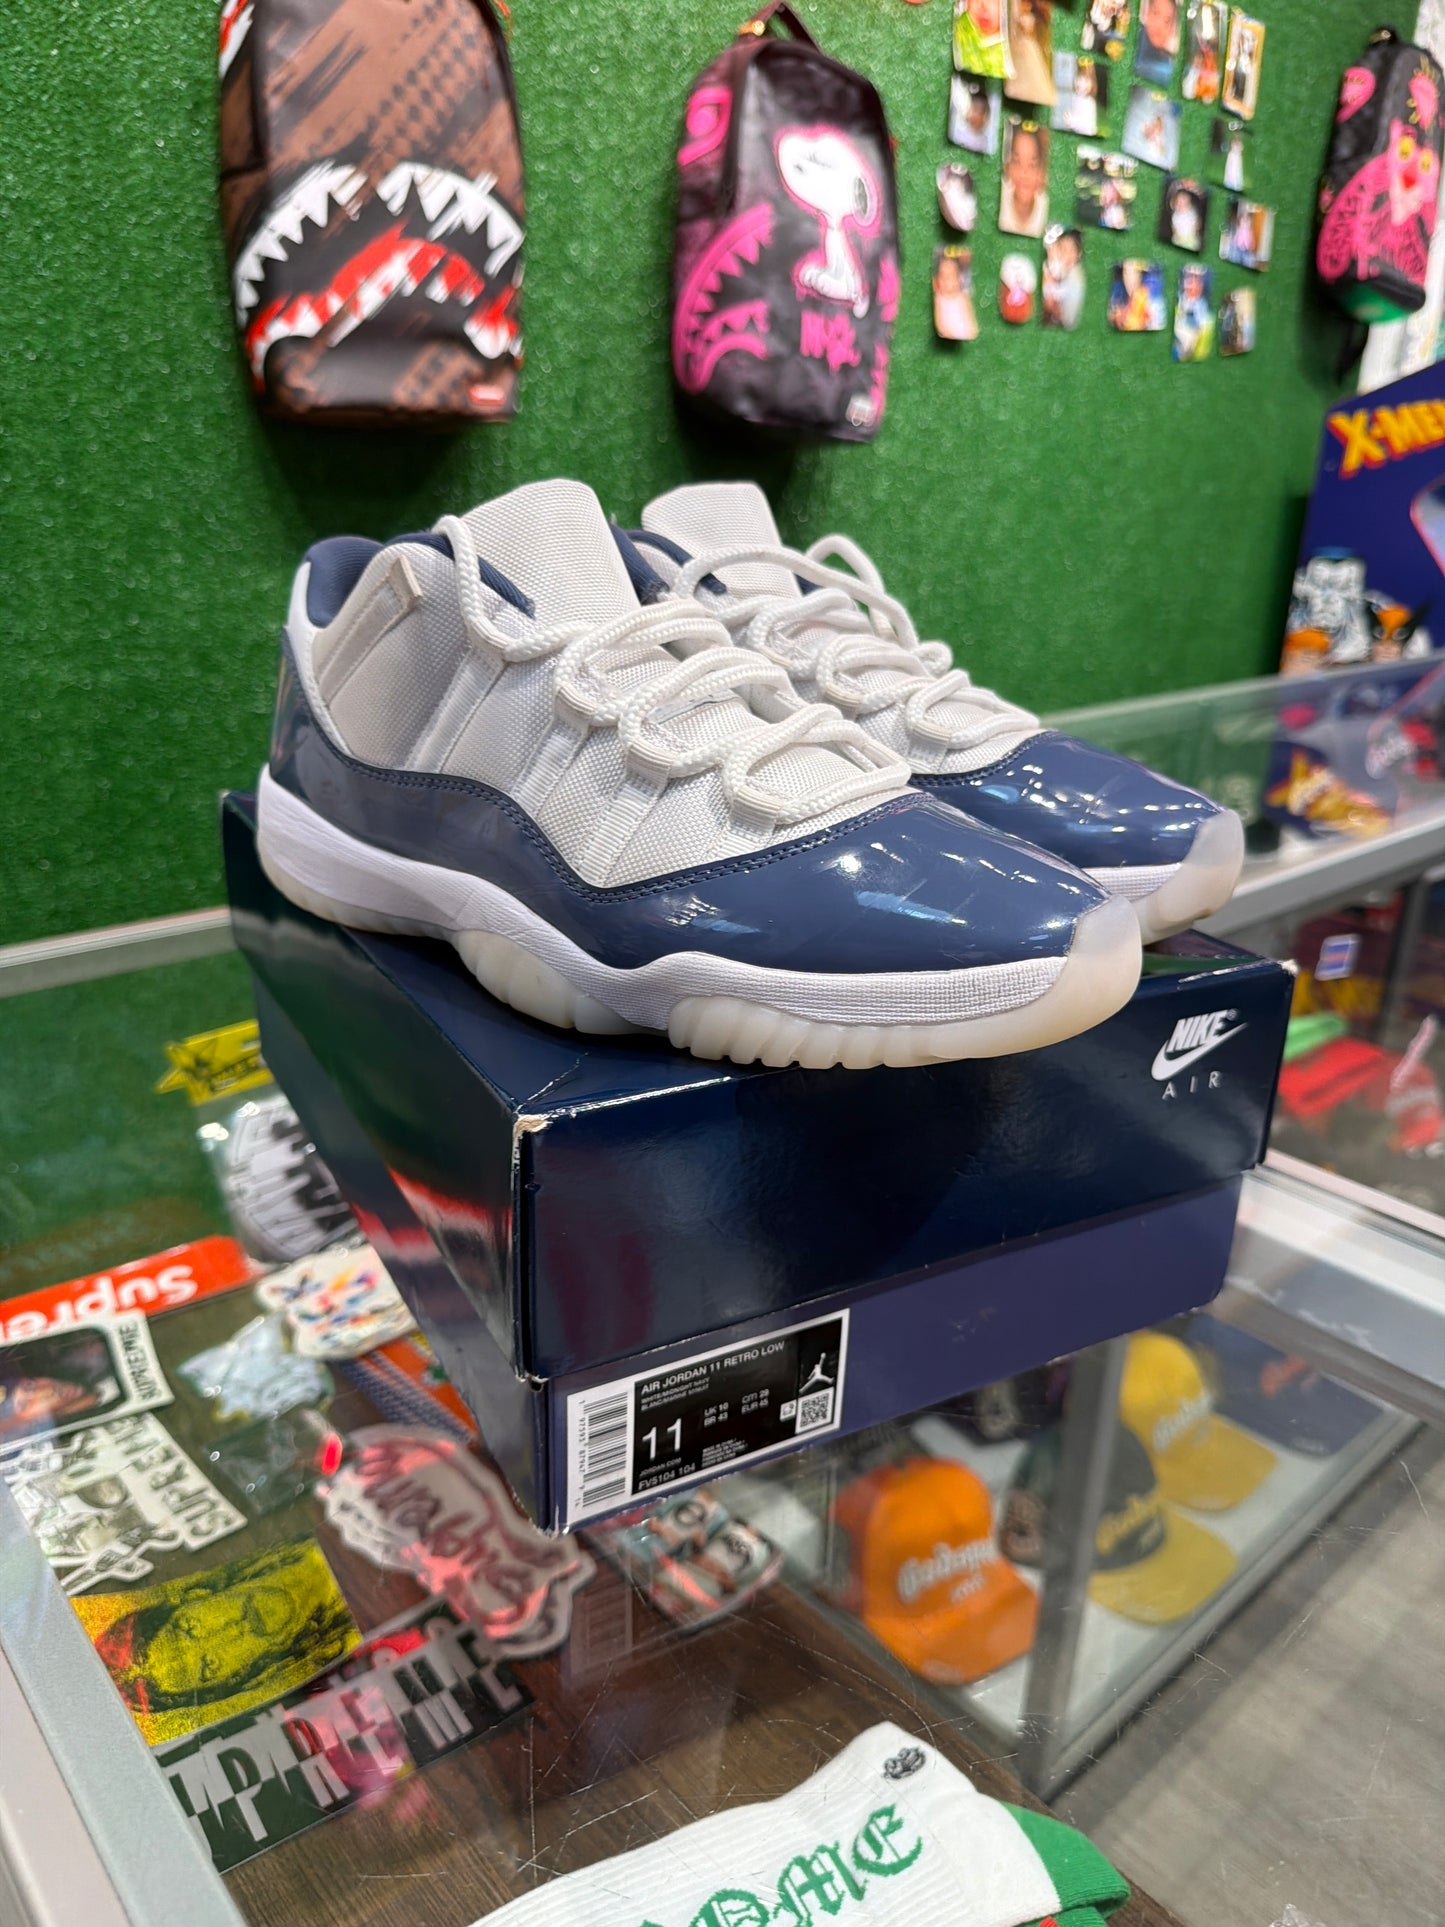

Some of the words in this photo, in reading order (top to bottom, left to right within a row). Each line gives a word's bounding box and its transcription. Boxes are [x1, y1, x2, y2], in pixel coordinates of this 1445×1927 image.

[1326, 399, 1445, 480] X-ME
[1165, 1009, 1229, 1053] NIKE
[1162, 1070, 1222, 1100] AIR
[0, 1264, 199, 1343] Supre
[641, 1381, 660, 1396] AIR
[662, 1365, 707, 1388] JORDAN
[709, 1361, 721, 1373] 11
[724, 1349, 760, 1368] RETRO
[761, 1340, 785, 1356] LOW
[741, 1402, 758, 1415] EUR
[758, 1397, 769, 1408] 45
[759, 1388, 770, 1400] 29
[704, 1407, 717, 1417] UK
[719, 1402, 729, 1413] 10
[704, 1415, 717, 1427] BR
[717, 1411, 729, 1422] 43
[642, 1417, 682, 1460] 11
[678, 1462, 696, 1475] 104
